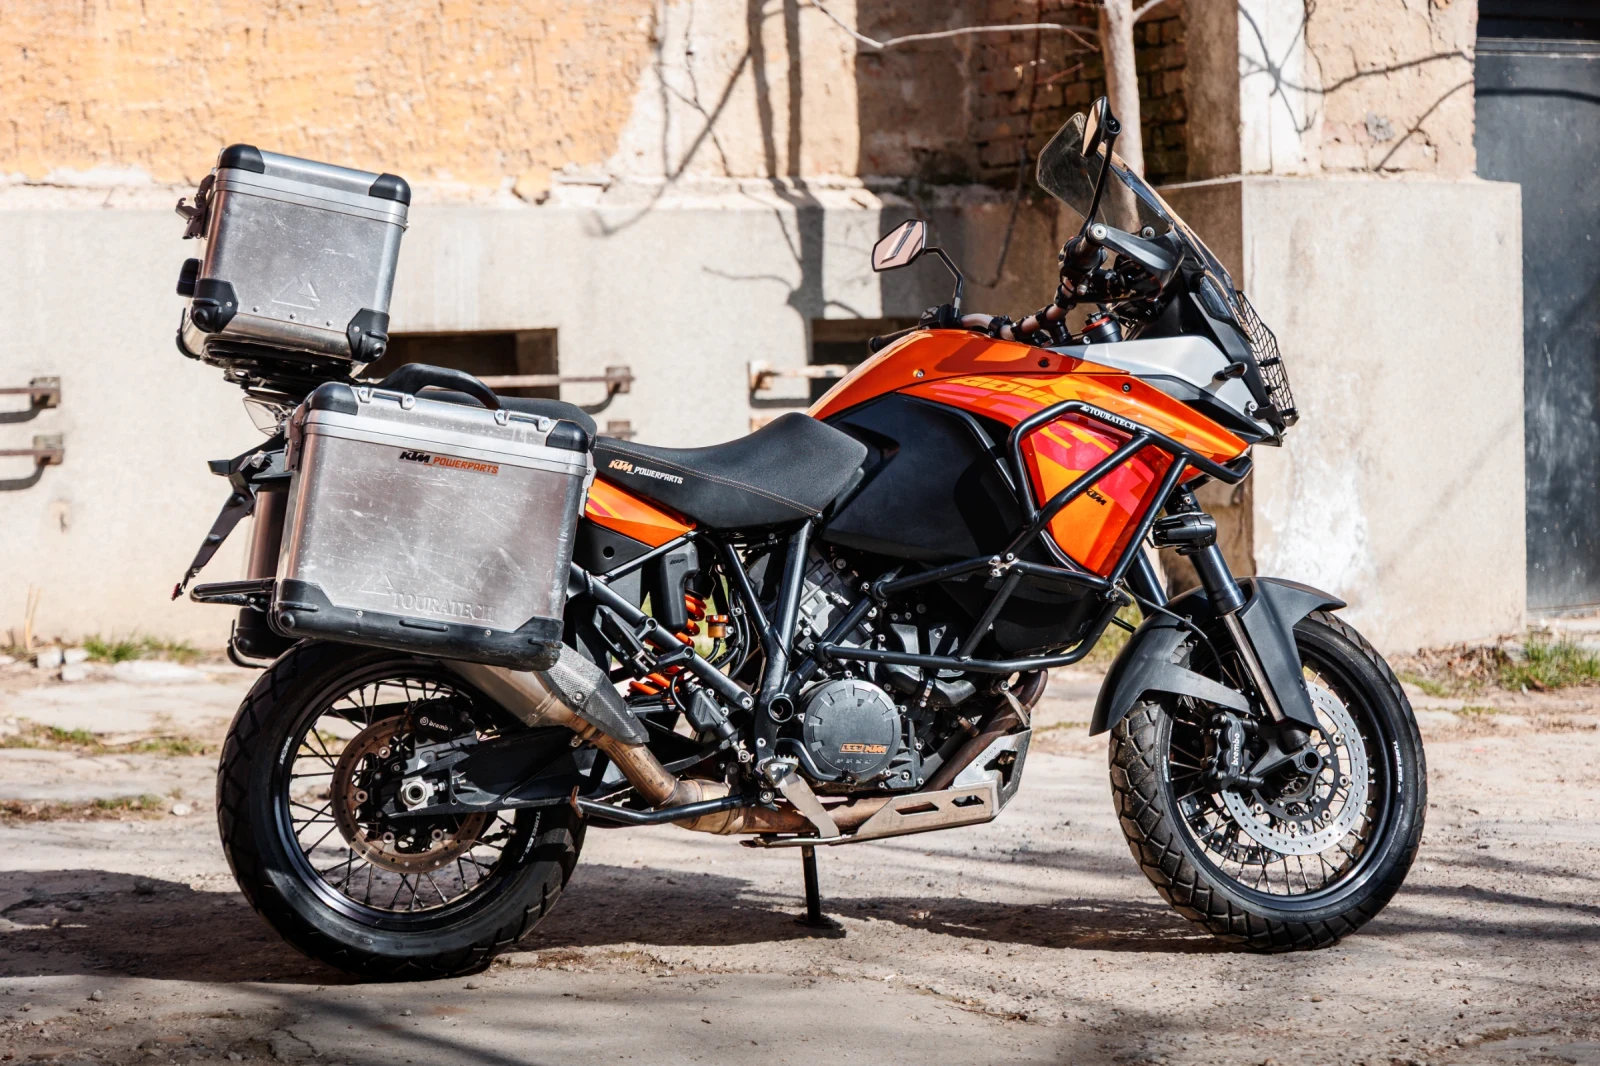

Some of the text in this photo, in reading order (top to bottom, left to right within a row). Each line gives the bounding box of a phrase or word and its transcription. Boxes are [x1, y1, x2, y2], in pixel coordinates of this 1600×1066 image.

[1089, 406, 1136, 430] TOURATECH
[399, 450, 499, 474] KTM POWERPARTS
[608, 459, 684, 484] KTM POWERPARTS
[391, 591, 496, 623] TOURATECH
[1231, 732, 1241, 766] brembo
